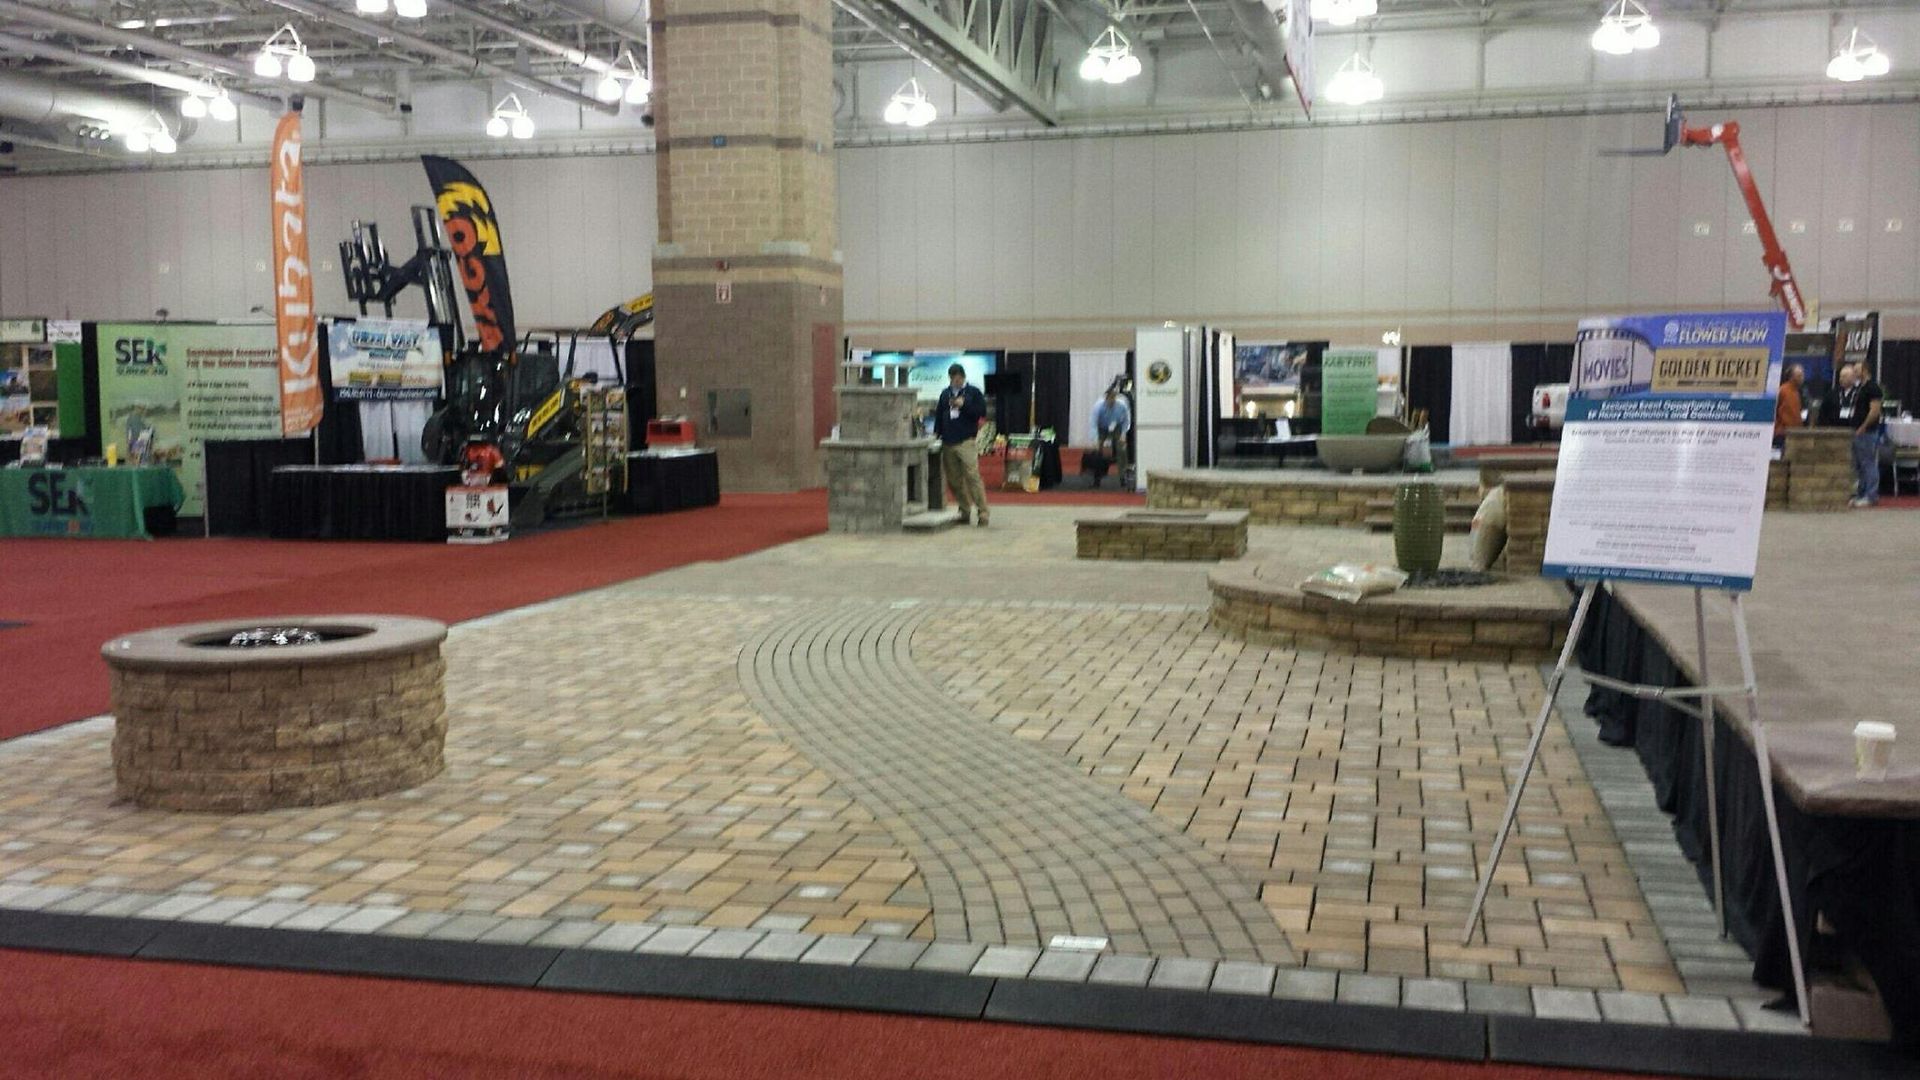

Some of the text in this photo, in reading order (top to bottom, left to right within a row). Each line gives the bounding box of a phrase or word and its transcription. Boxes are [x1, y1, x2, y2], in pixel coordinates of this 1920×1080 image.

[275, 137, 320, 394] Kubota
[1680, 327, 1727, 344] FLOWER
[1729, 327, 1769, 344] SHOW
[1583, 357, 1629, 383] MOVIES
[1660, 358, 1760, 378] GOLDEN TICKET
[1663, 400, 1717, 412] Opportunity
